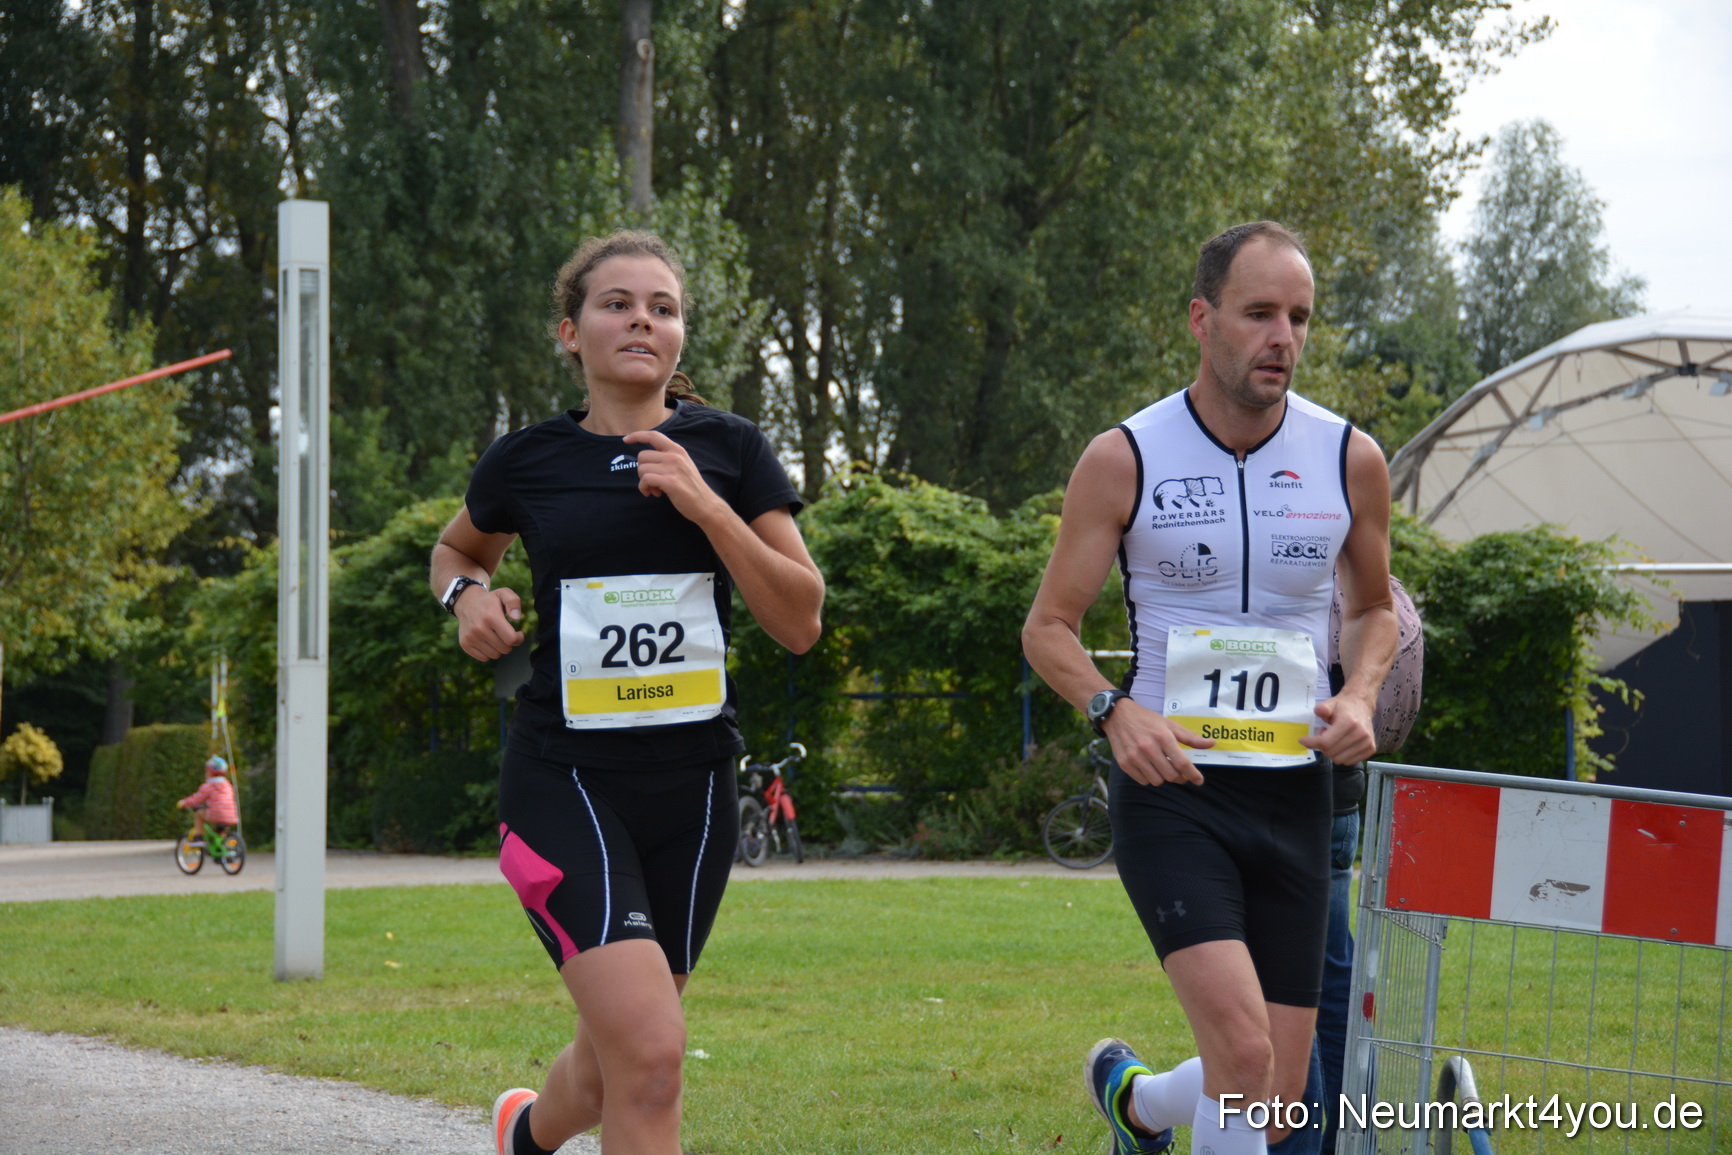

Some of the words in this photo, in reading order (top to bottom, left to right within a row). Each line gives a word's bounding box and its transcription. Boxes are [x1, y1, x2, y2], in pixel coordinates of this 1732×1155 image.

[1269, 481, 1303, 489] skinfit
[1152, 509, 1225, 522] POWERBÄRS
[1253, 510, 1284, 518] VELO
[1285, 511, 1342, 520] emozione
[1152, 517, 1225, 529] Rednitzhembach
[1271, 534, 1331, 542] ELEKTROMOTOREN
[1271, 540, 1329, 560] ROCK
[621, 589, 676, 603] BOCK
[600, 621, 685, 668] 262
[1225, 639, 1277, 653] BOCK
[617, 684, 674, 701] Larissa
[1203, 669, 1280, 713] 110
[1202, 724, 1275, 743] Sebastian
